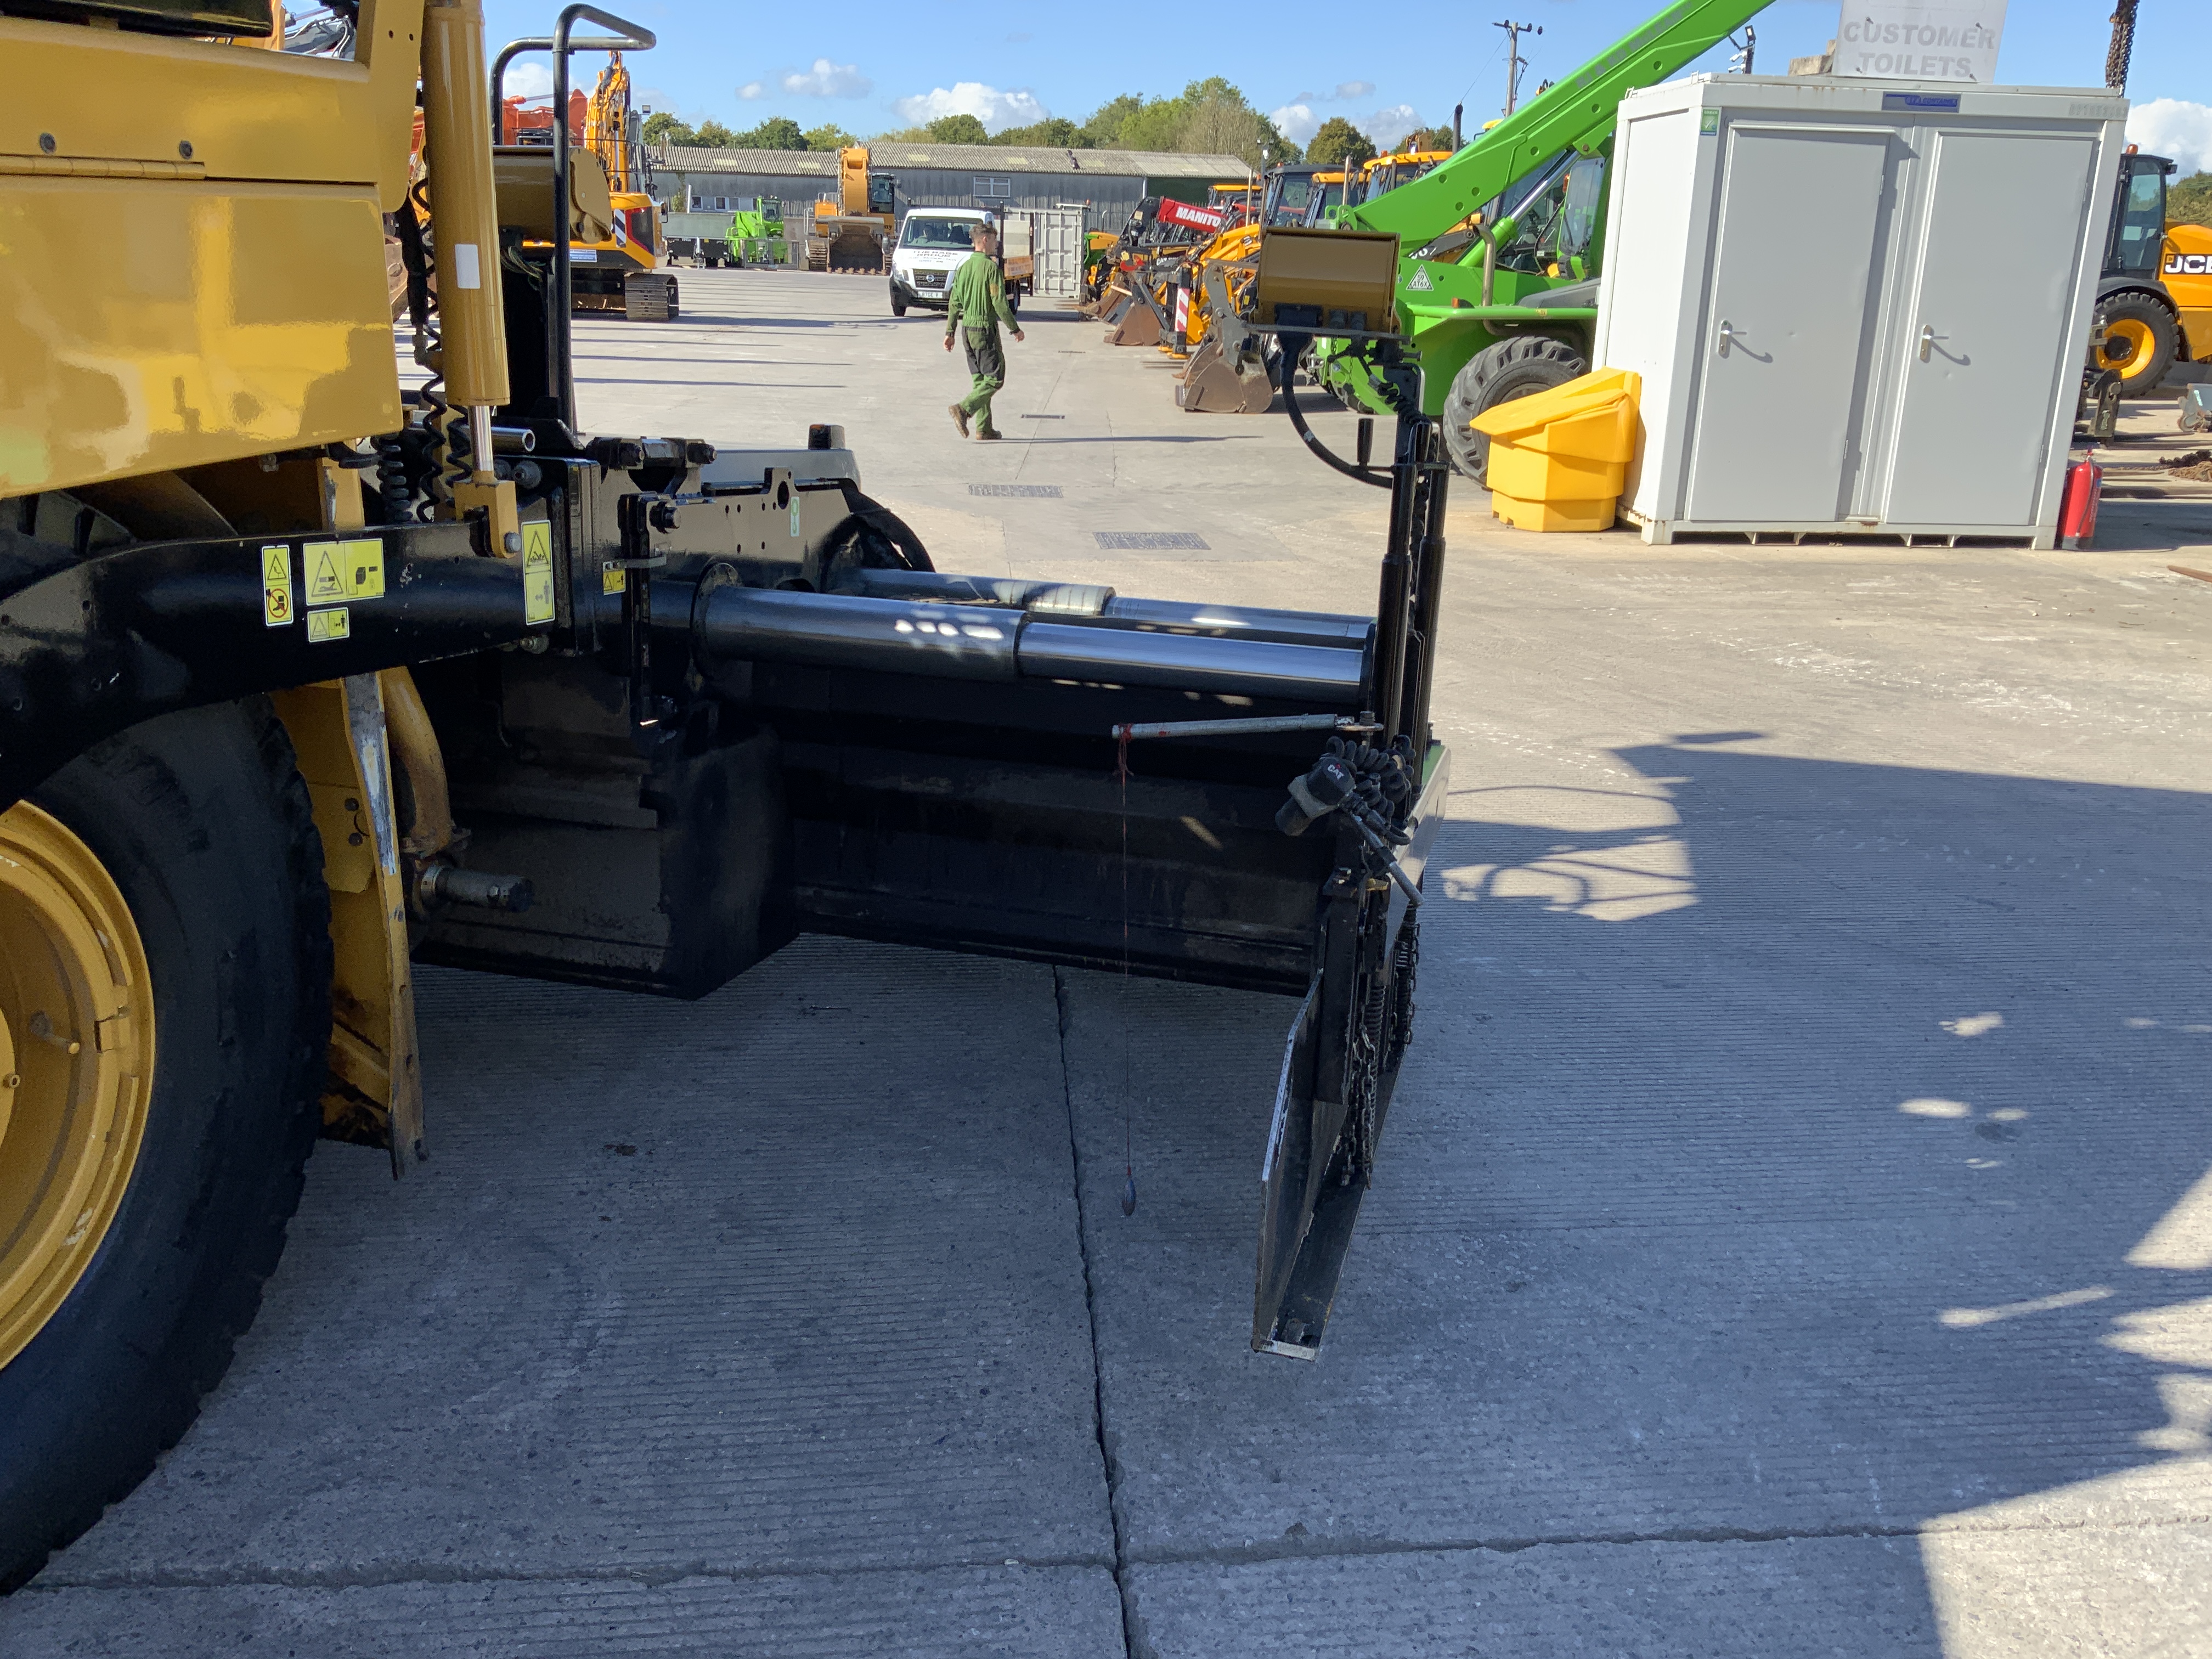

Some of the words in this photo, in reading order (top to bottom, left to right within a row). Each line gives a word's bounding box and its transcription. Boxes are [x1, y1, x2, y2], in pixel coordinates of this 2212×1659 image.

[1843, 21, 1996, 49] CUSTOMER
[1858, 52, 1972, 77] TOILETS
[1176, 205, 1221, 228] MANITO
[1328, 764, 1344, 780] CAT
